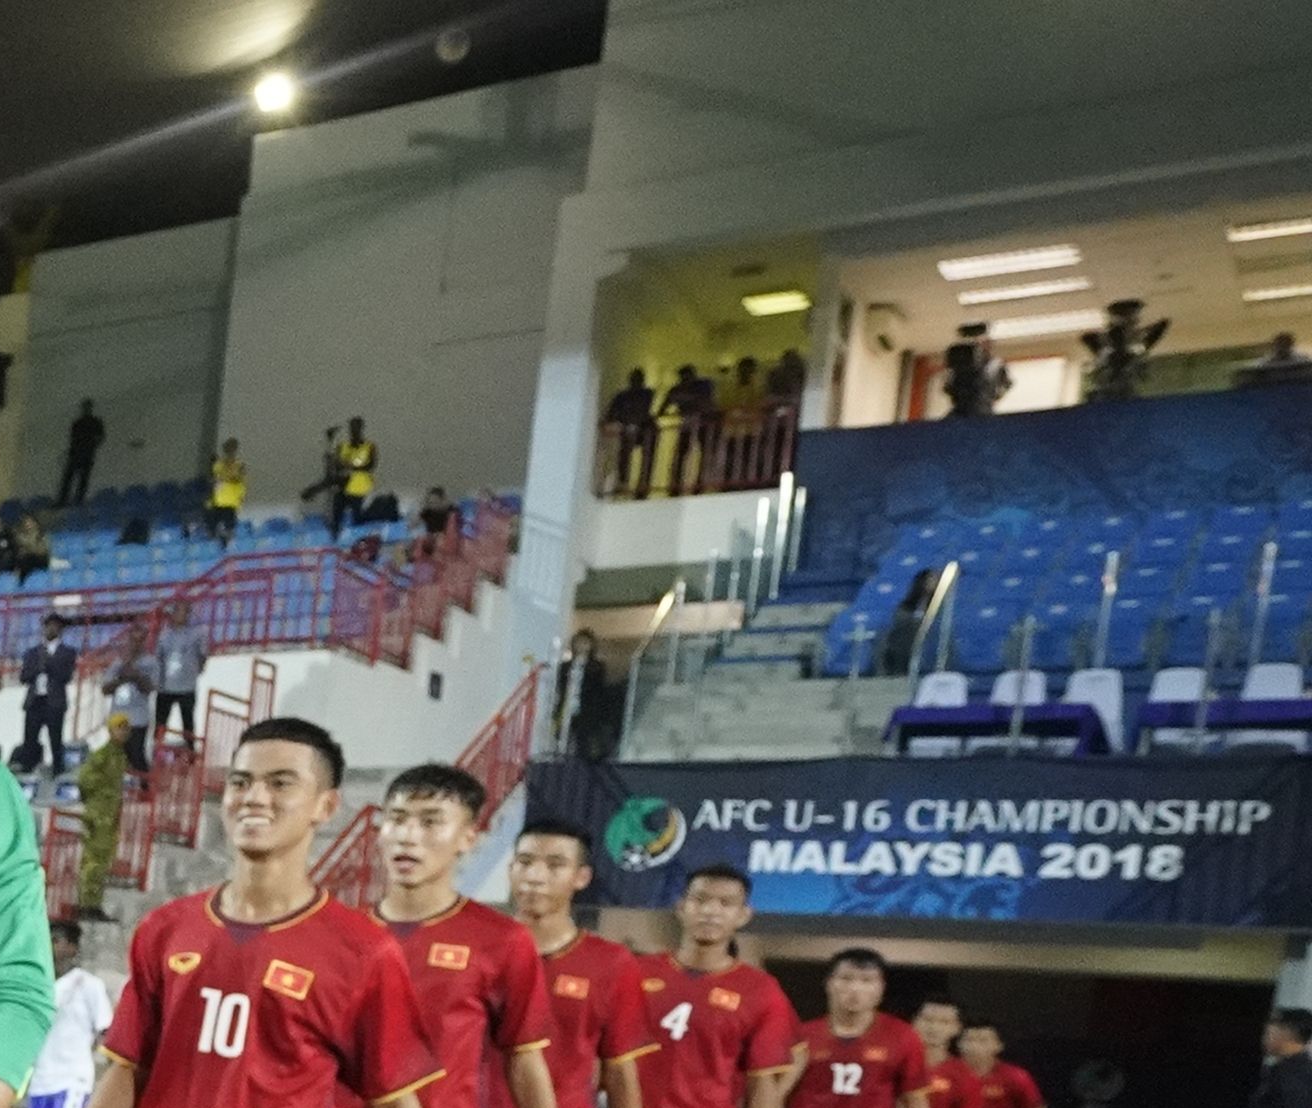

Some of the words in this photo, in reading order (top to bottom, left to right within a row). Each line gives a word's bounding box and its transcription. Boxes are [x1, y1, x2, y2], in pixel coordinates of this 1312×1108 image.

[691, 799, 773, 832] AFC
[784, 799, 892, 833] U-16
[904, 799, 1272, 835] CHAMPIONSHIP
[747, 839, 1024, 878] MALAYSIA
[1037, 843, 1184, 882] 2018
[197, 987, 250, 1058] 10
[660, 1001, 693, 1041] 4
[830, 1062, 863, 1095] 12
